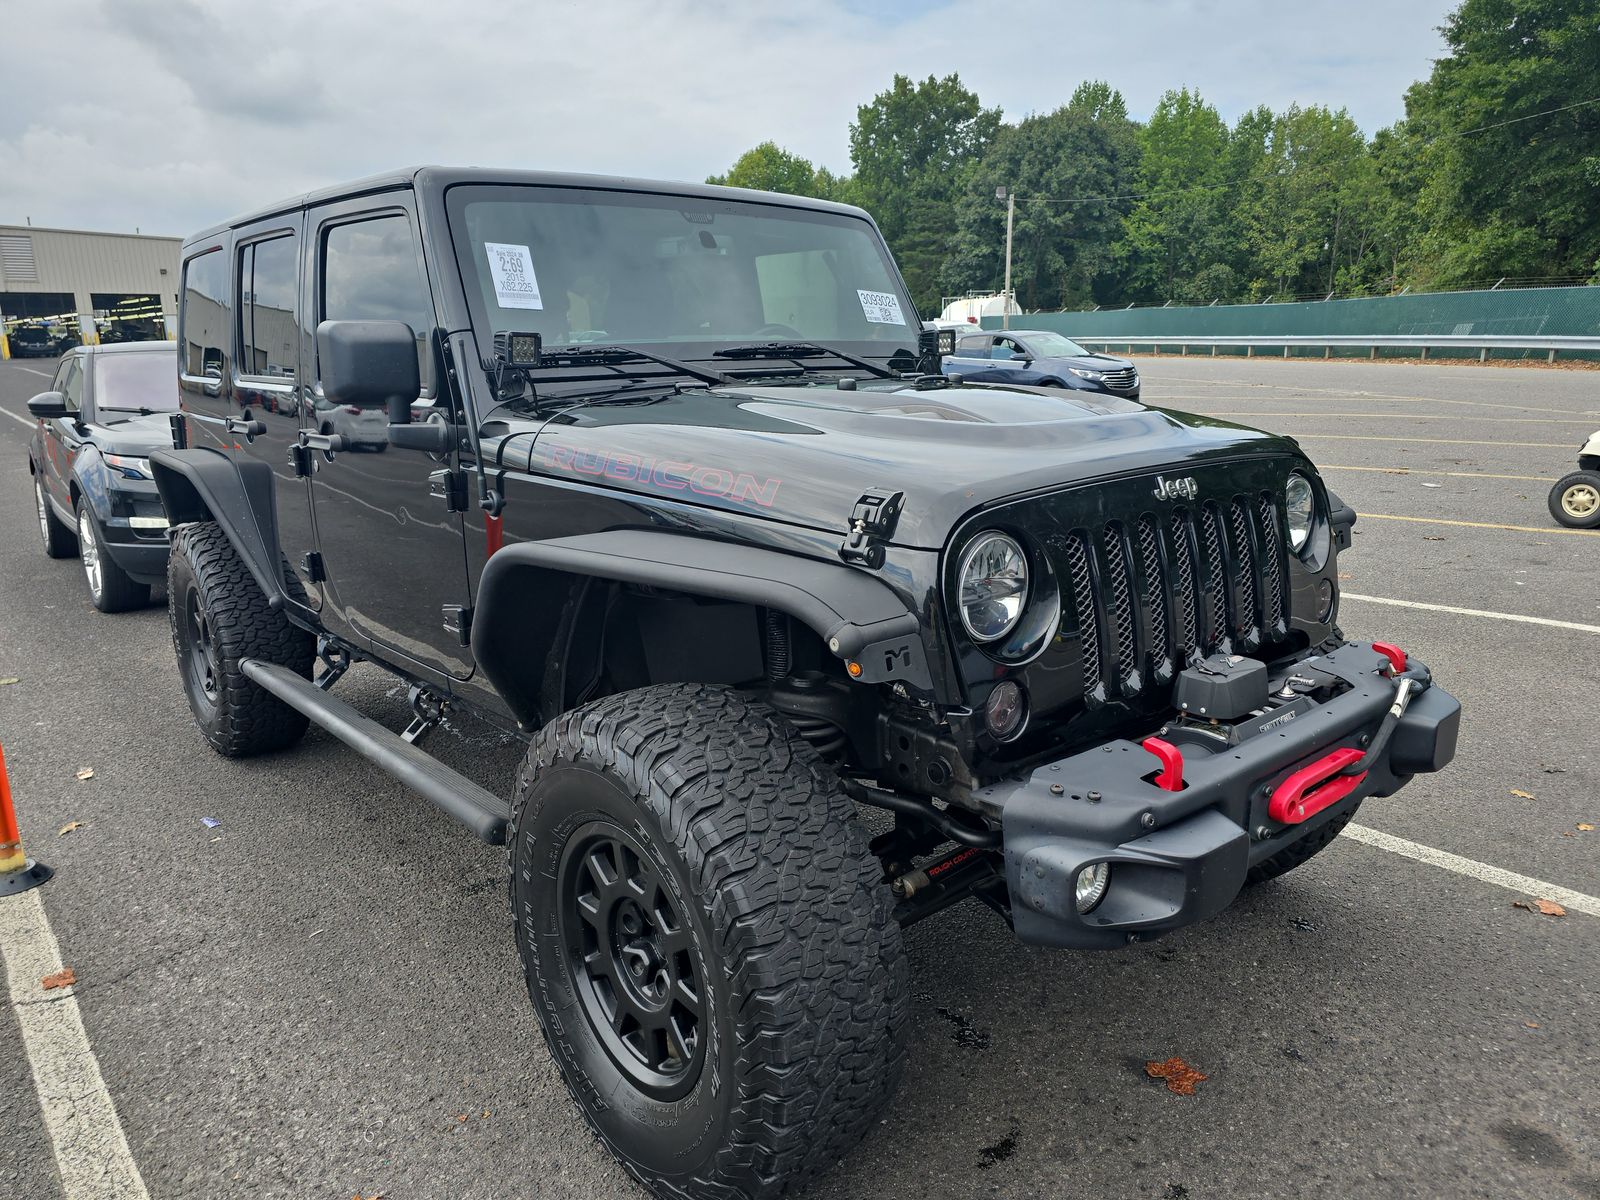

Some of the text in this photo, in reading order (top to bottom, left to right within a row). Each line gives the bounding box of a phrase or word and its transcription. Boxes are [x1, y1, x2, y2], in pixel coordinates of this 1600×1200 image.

[499, 256, 524, 273] 2:69
[505, 272, 526, 282] 2015
[861, 293, 897, 307] 3093024
[543, 446, 783, 507] RUBICON
[1153, 475, 1199, 501] Jeep
[929, 862, 952, 876] ROUGH
